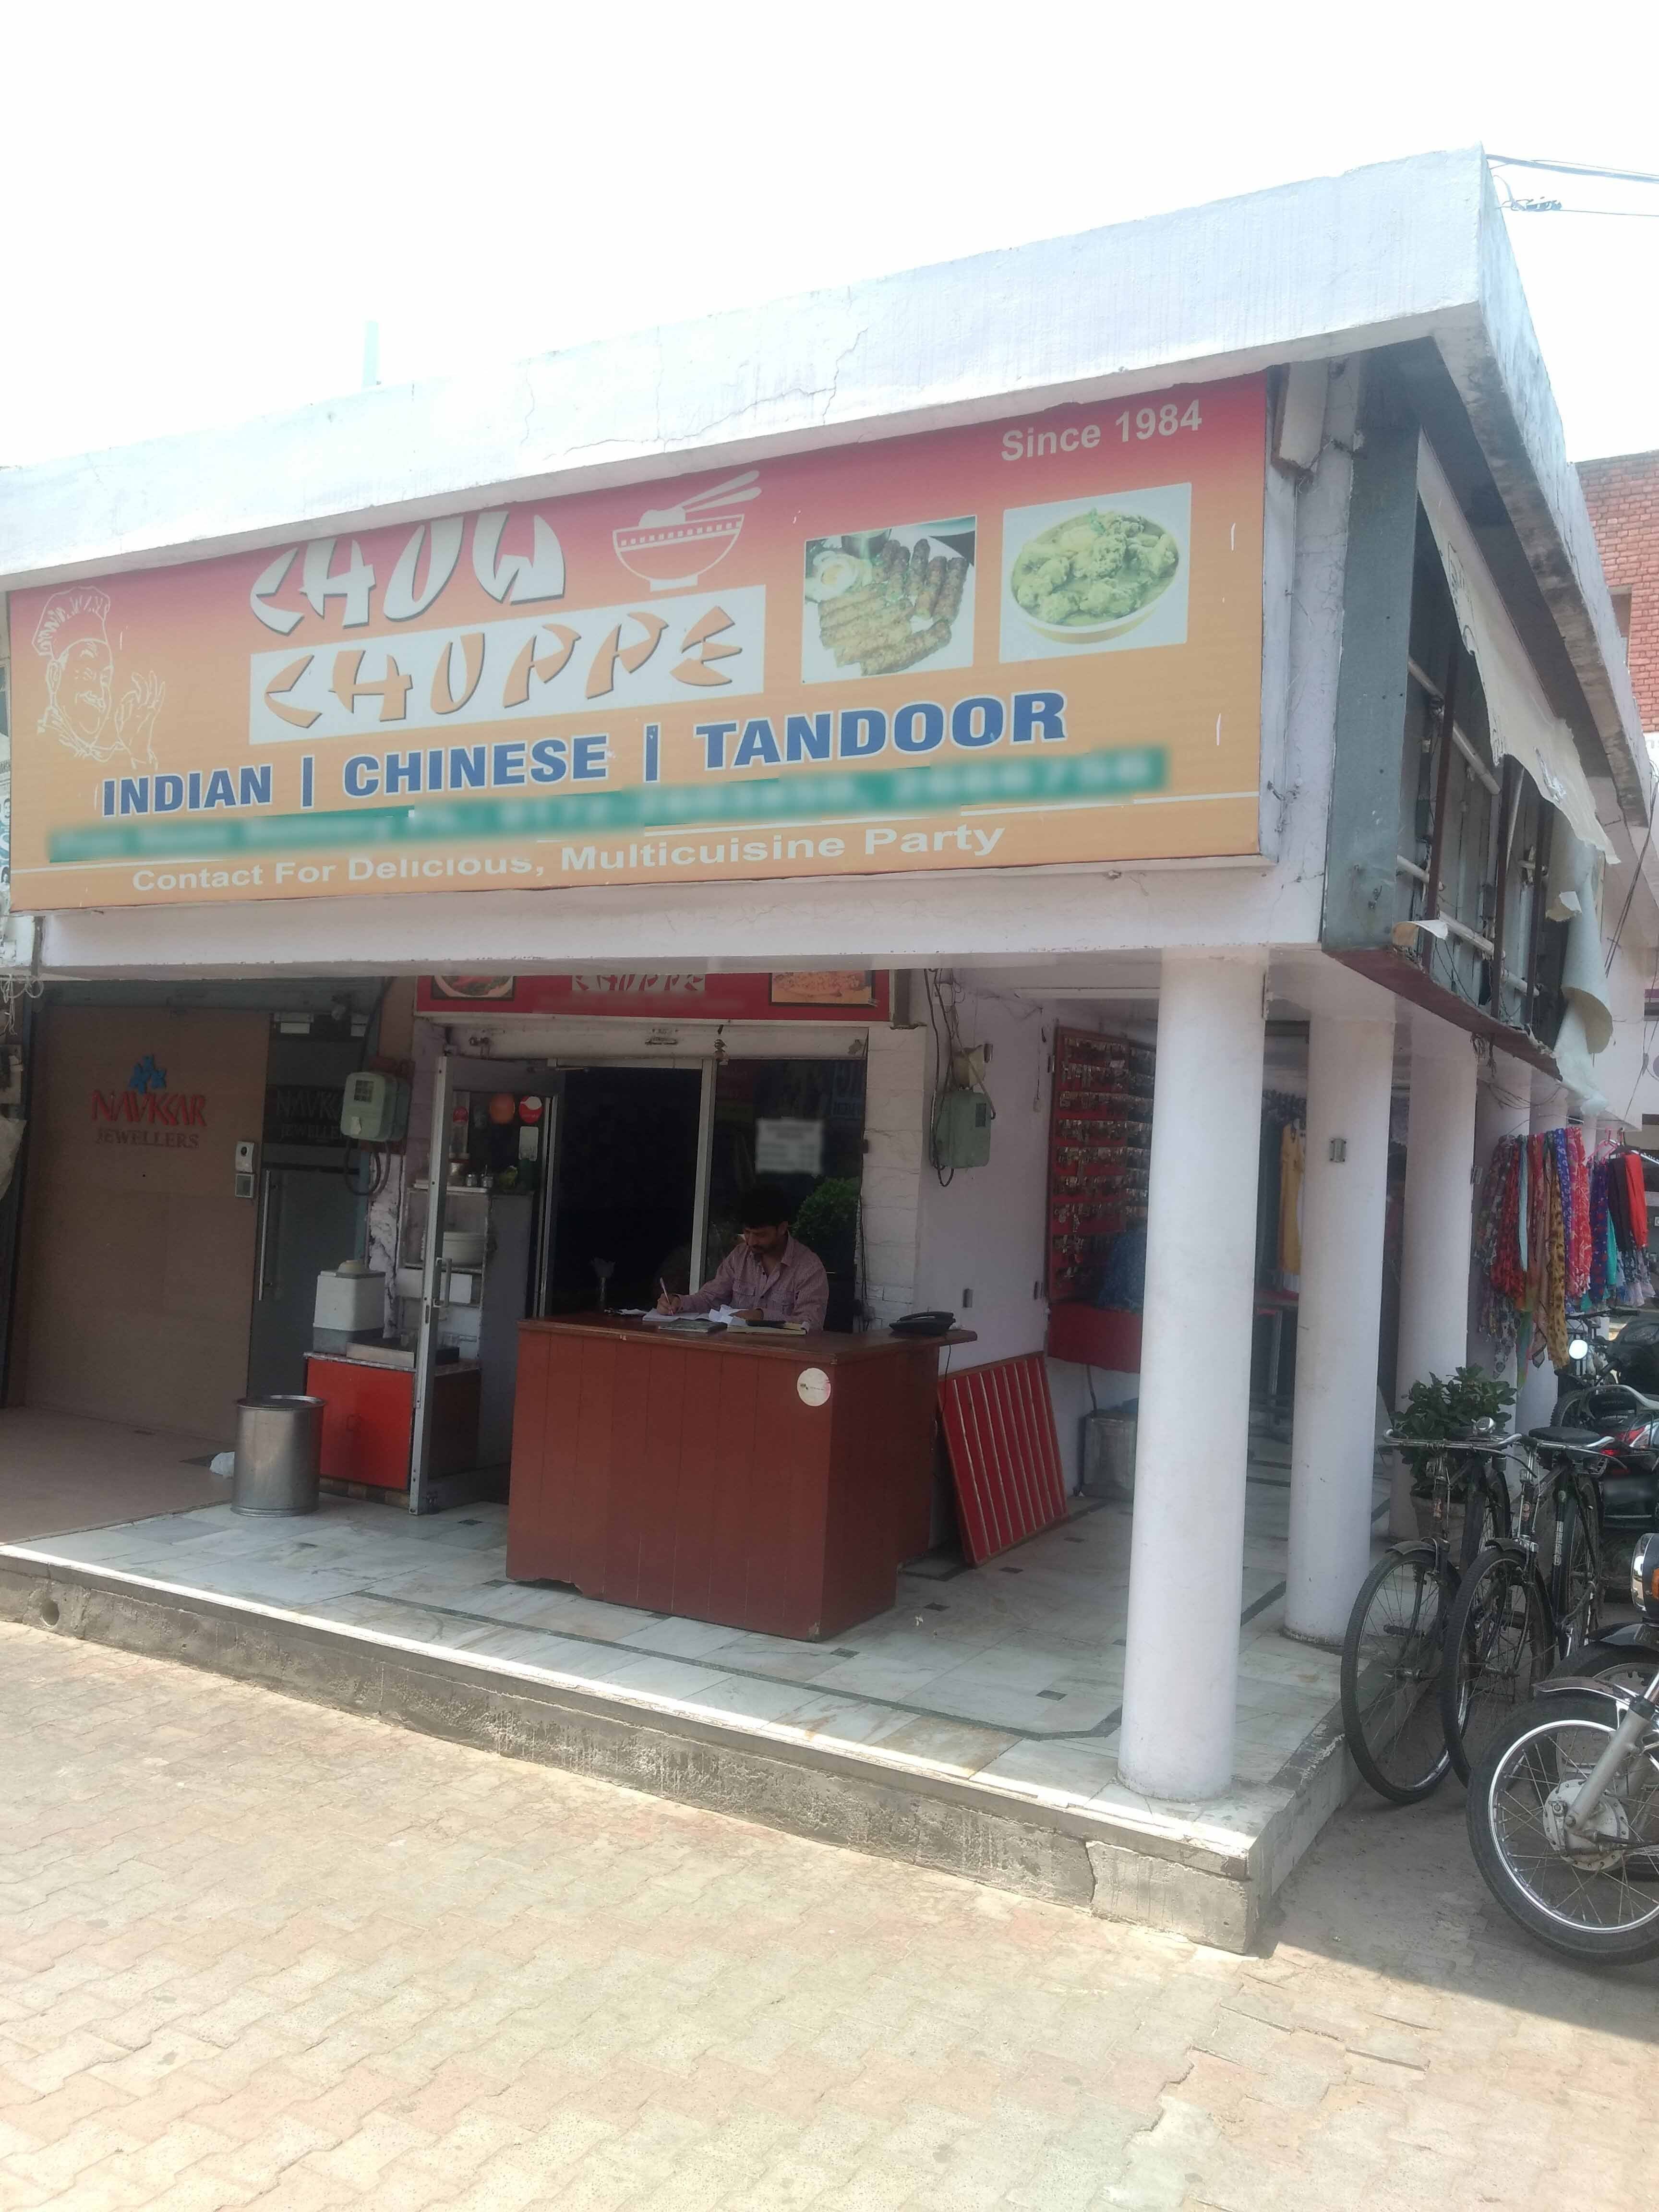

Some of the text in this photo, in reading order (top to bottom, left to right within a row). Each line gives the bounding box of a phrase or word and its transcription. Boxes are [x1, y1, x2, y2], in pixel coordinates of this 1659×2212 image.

[1001, 399, 1202, 461] Since 1984
[249, 511, 566, 636] CHOW
[264, 606, 743, 728] CHUPPE
[101, 764, 273, 817] INDIAN
[342, 734, 609, 798] CHINESE
[695, 689, 1068, 771] TANDOOR
[132, 824, 1005, 891] Contact For Delicious, Multicuisine Party
[92, 1089, 207, 1127] NAVKAR
[95, 1129, 199, 1149] JEWELLERS
